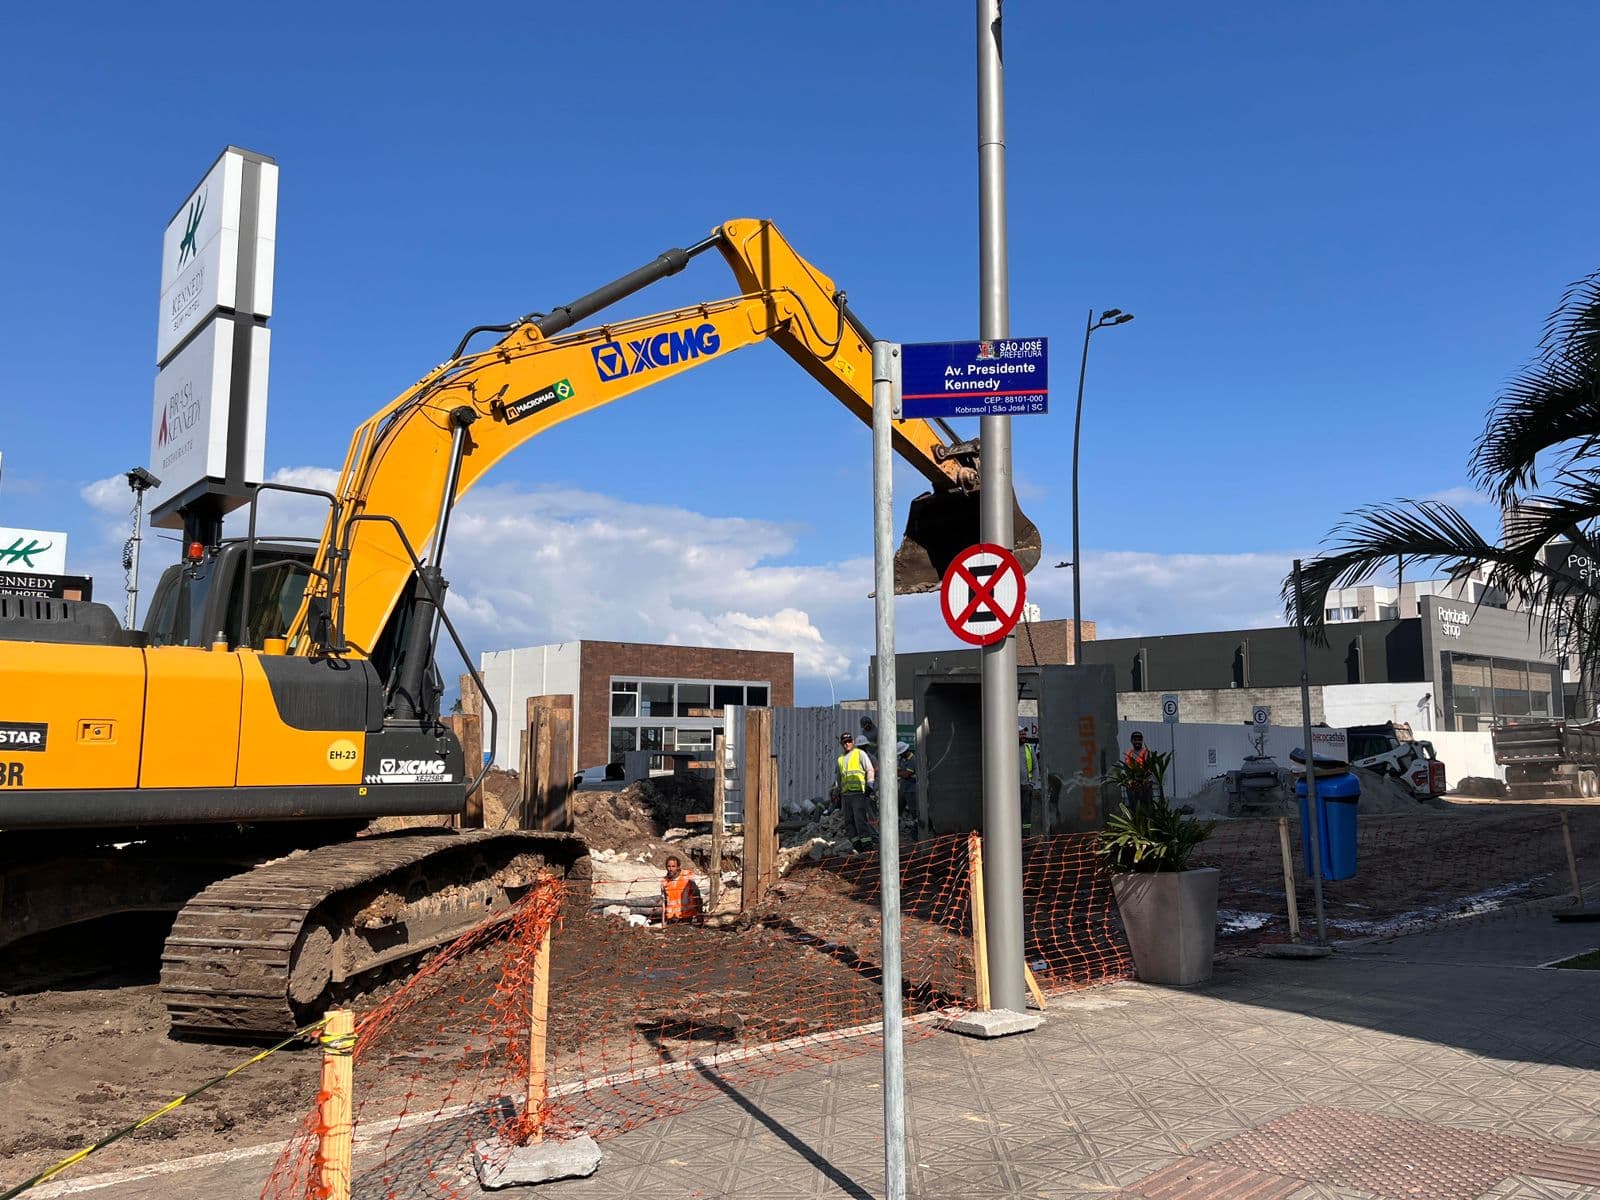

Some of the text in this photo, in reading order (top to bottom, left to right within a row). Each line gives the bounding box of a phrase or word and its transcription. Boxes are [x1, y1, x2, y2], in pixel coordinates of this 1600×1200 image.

[627, 323, 720, 375] XCMG
[1000, 339, 1042, 351] SÃO JOSÉ
[1000, 350, 1042, 359] PREFEITURA
[945, 363, 1036, 376] Av. Presidente
[945, 378, 1000, 391] Kennedy
[516, 391, 555, 413] MACROMAQ
[1005, 395, 1043, 404] 88101-000
[955, 405, 986, 414] Kobrasol
[992, 404, 1007, 413] São
[1008, 404, 1025, 412] José
[1031, 403, 1043, 411] SC
[15, 590, 50, 599] HOTEL
[1442, 621, 1460, 639] shop
[329, 750, 356, 760] EH-23
[396, 760, 446, 774] XCMG
